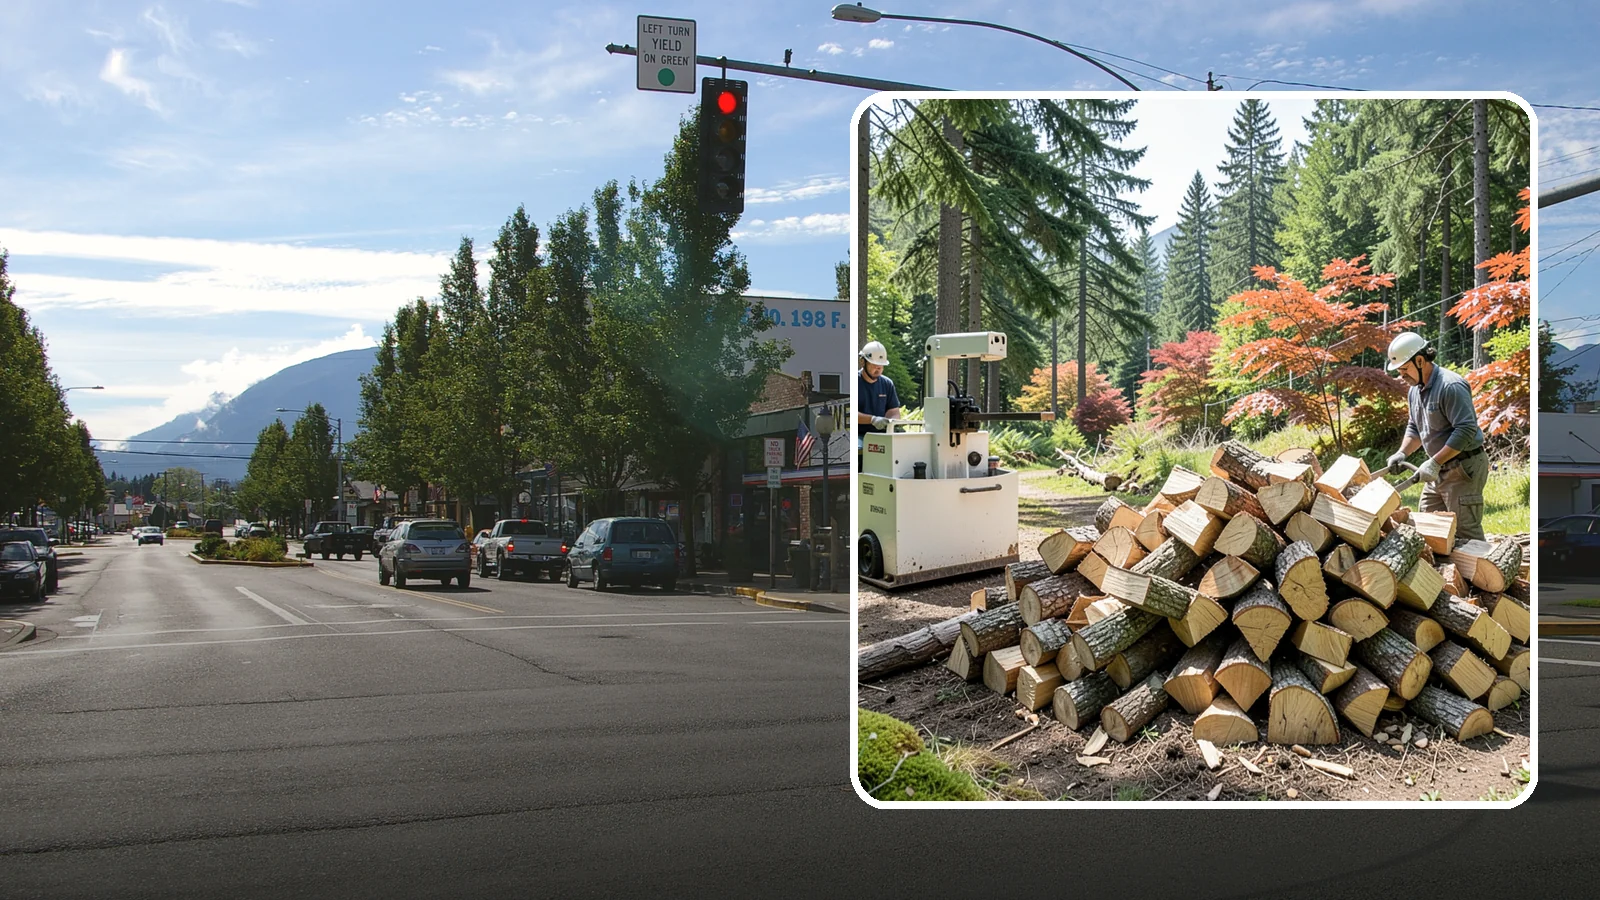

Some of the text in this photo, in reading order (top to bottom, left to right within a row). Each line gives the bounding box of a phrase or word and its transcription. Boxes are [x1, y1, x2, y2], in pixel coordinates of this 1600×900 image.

[642, 23, 690, 36] LEFT TURN
[652, 38, 682, 52] YIELD
[644, 53, 688, 66] ON GREEN
[791, 309, 826, 328] 198
